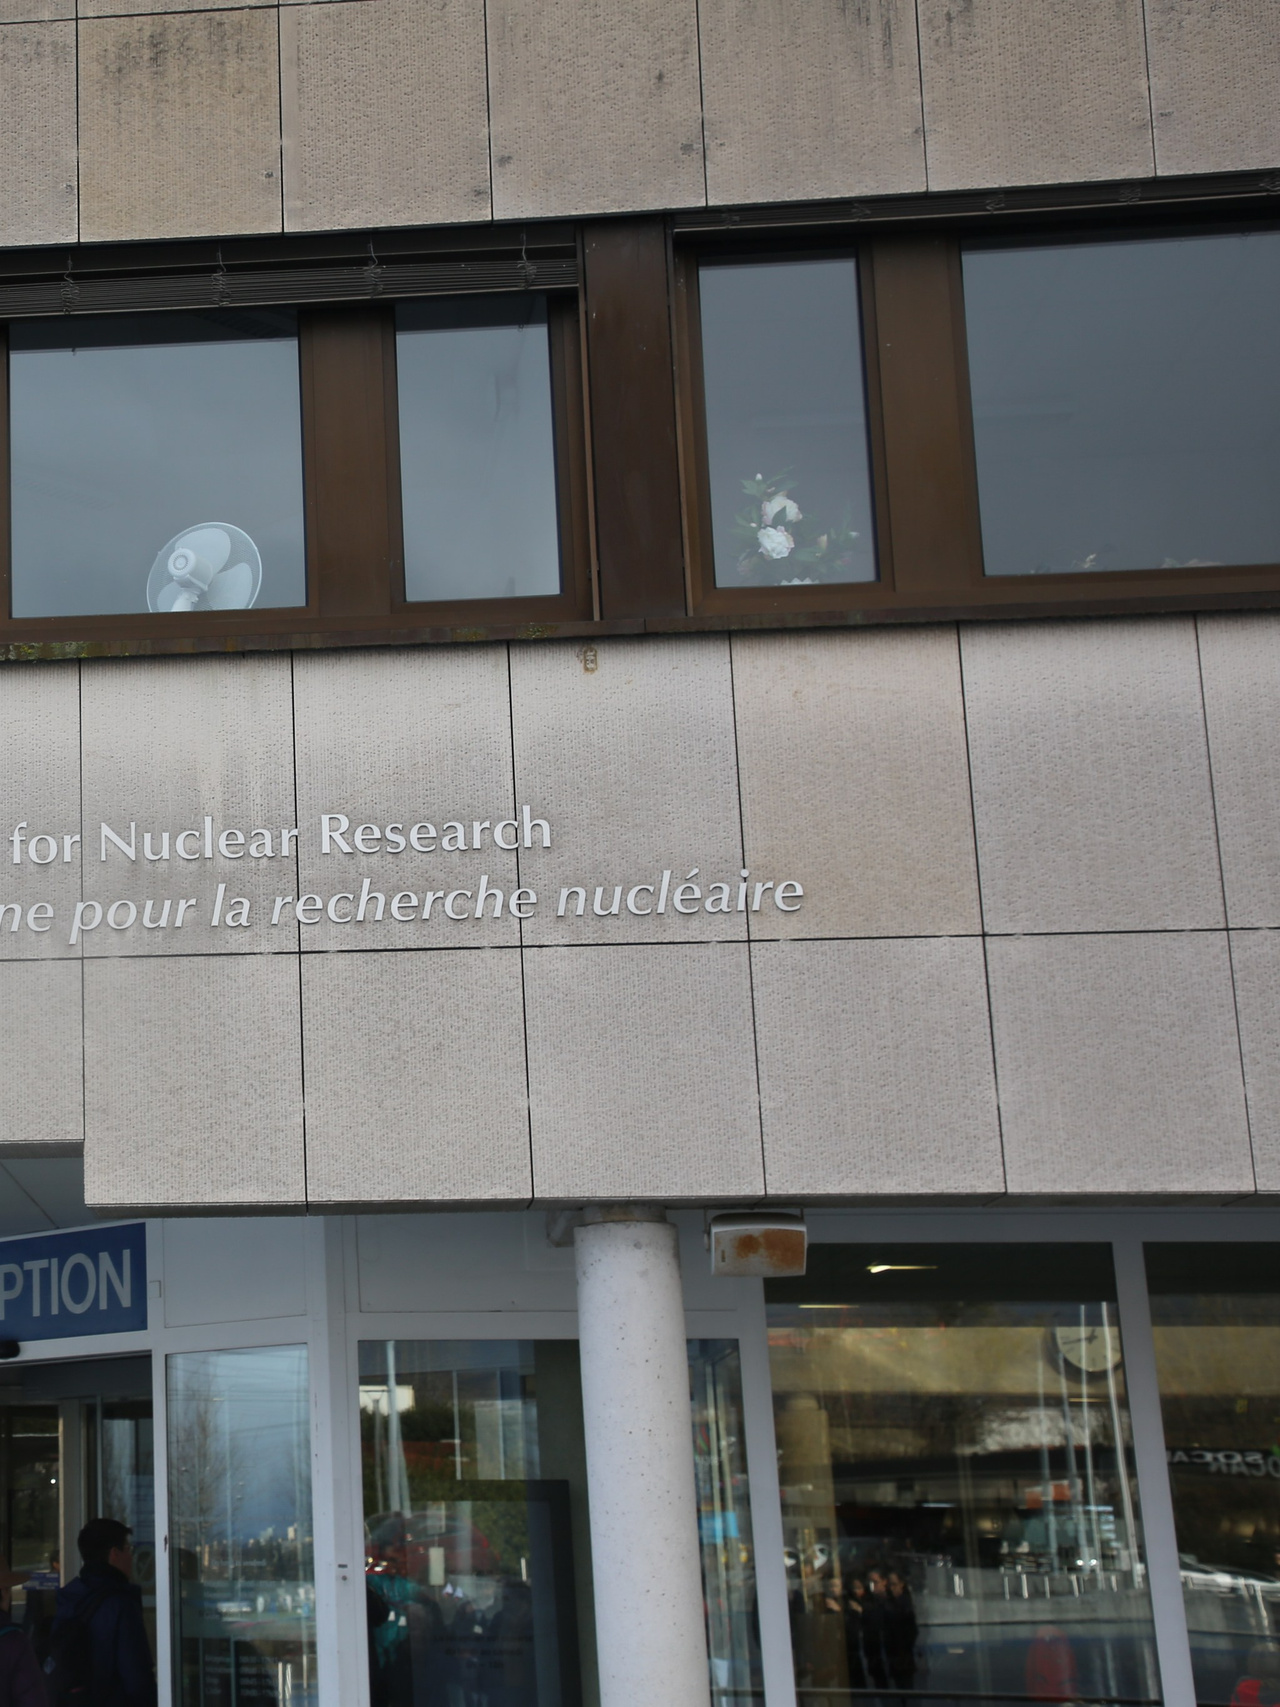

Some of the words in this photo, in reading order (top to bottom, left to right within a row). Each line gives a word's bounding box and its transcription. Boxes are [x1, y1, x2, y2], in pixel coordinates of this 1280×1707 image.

[9, 823, 81, 864] for
[100, 816, 298, 861] Nuclear
[320, 805, 551, 854] Research
[69, 898, 196, 945] pour
[210, 883, 251, 928] la
[271, 875, 537, 926] recherche
[556, 868, 804, 917] nucléaire
